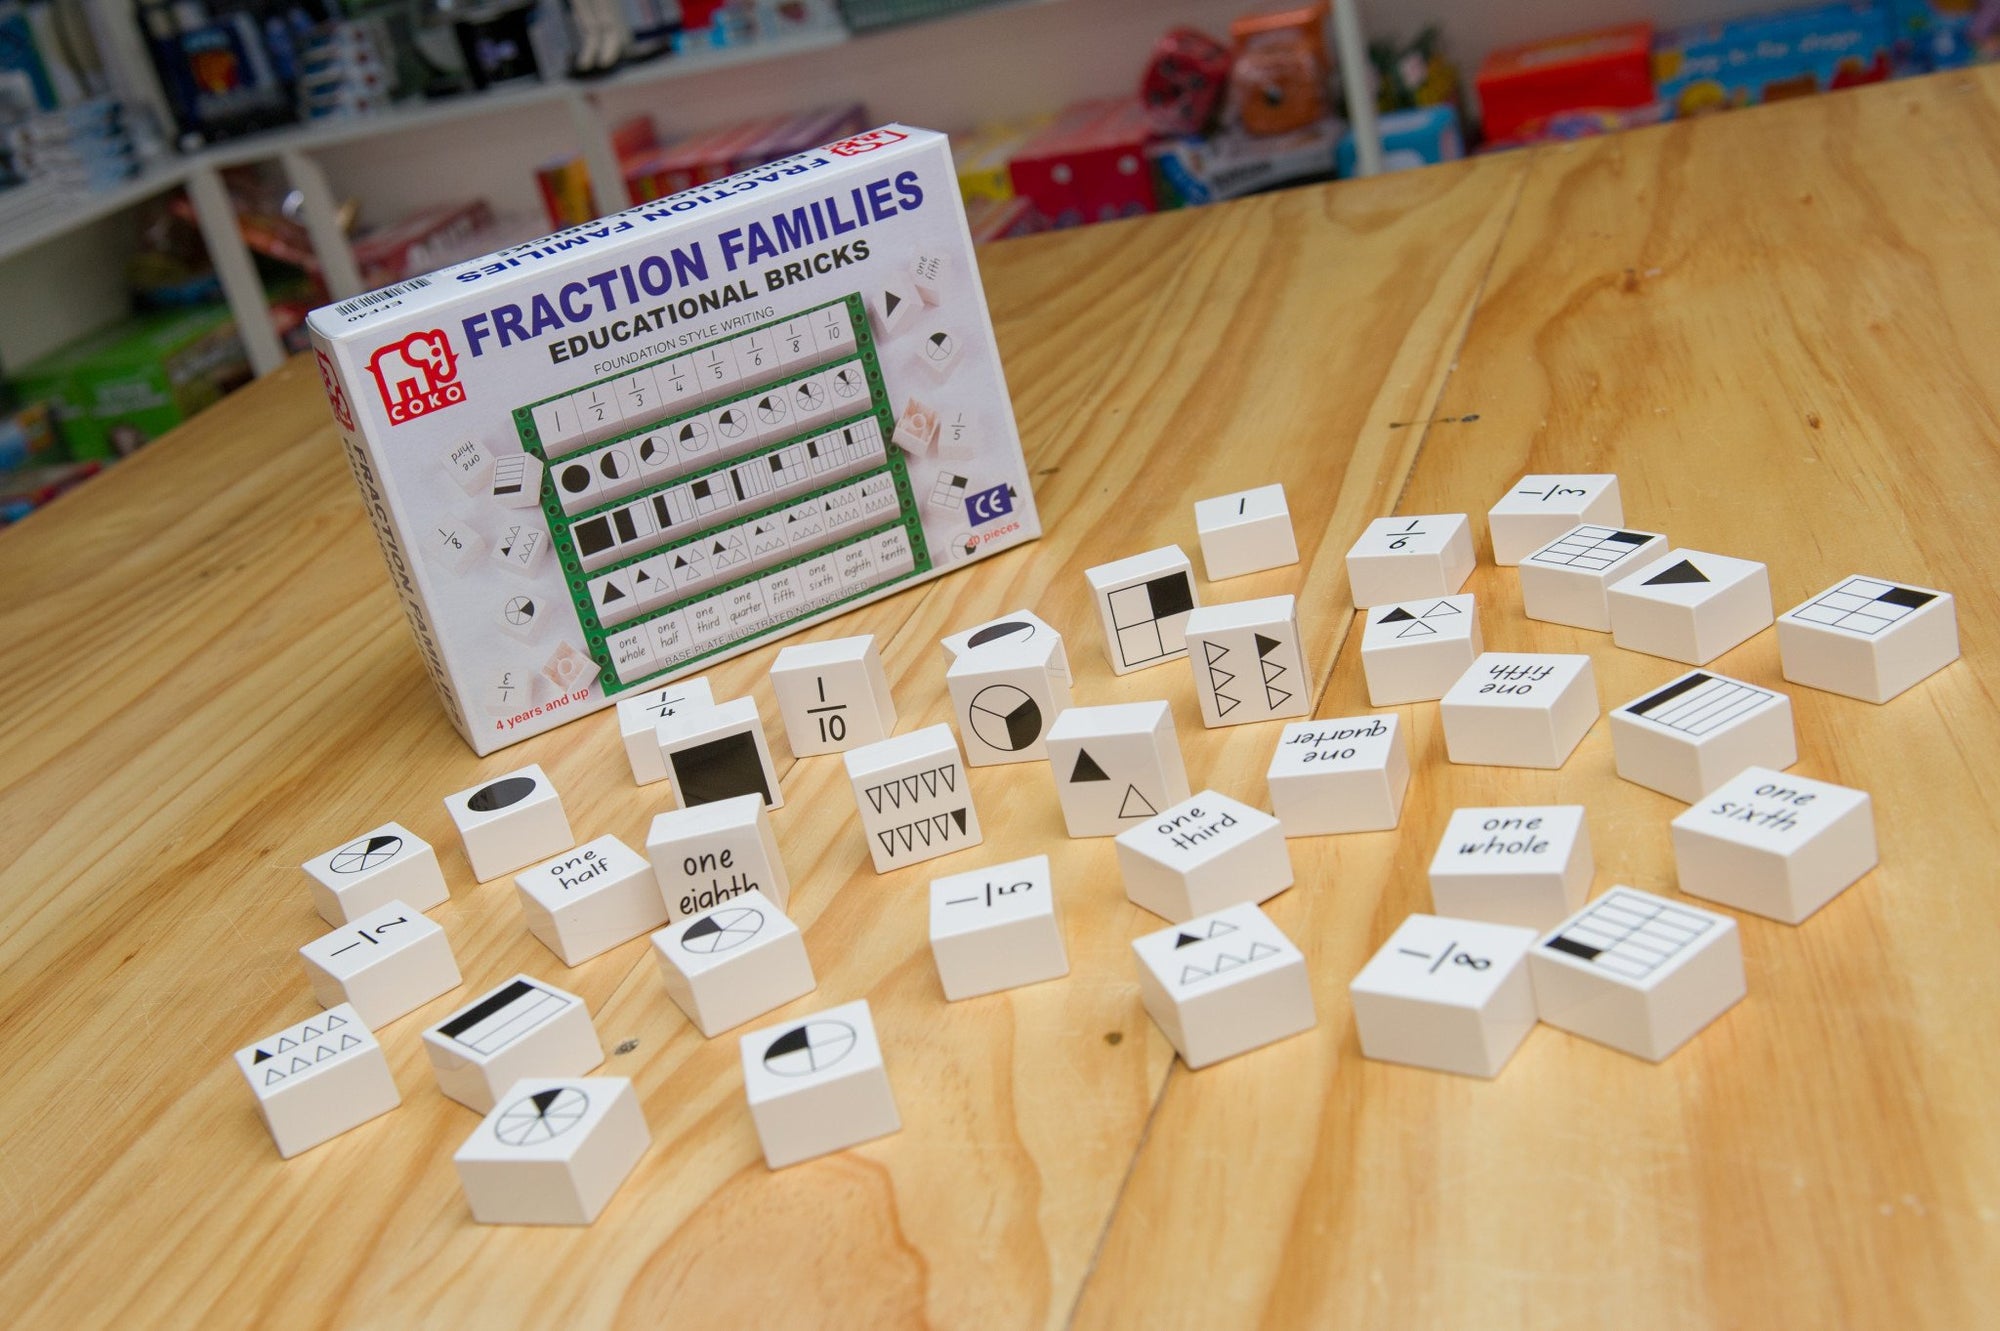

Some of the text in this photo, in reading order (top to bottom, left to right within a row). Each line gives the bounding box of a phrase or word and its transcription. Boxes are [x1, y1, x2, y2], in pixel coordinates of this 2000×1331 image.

[642, 157, 831, 222] FRACTION
[456, 220, 634, 283] FAMILIES
[461, 170, 924, 357] FRACTION FAMILIES
[916, 255, 928, 276] one
[548, 239, 870, 364] EDUCATIONAL BRICKS
[594, 306, 775, 375] FOUNDATION STYLE WRITING
[391, 386, 461, 421] COKO
[451, 440, 476, 465] third
[463, 454, 480, 472] one
[353, 443, 414, 596] FRACTION
[881, 535, 899, 548] one
[983, 521, 1020, 543] pieces
[845, 549, 864, 562] one
[880, 546, 907, 562] tenth
[809, 564, 827, 577] one
[844, 559, 872, 578] eighth
[771, 577, 789, 590] one
[809, 574, 834, 591] sixth
[733, 592, 751, 605] one
[773, 588, 795, 605] fifth
[695, 606, 714, 619] one
[730, 602, 763, 627] quarter
[657, 621, 676, 634] one
[664, 581, 869, 666] BASE PLATE ILLUSTRATED NOT INCLUDED
[697, 617, 721, 633] third
[619, 635, 637, 649] one
[660, 631, 680, 648] half
[619, 646, 647, 664] whole
[1488, 663, 1555, 683] fifth
[1479, 682, 1533, 697] one
[495, 687, 590, 731] 4 years and up
[1285, 718, 1388, 748] quarter
[1302, 747, 1357, 764] one
[1754, 783, 1818, 807] one
[1158, 805, 1207, 837] one
[1482, 815, 1544, 832] one
[1711, 800, 1799, 833] sixth
[1170, 812, 1239, 853] third
[1458, 834, 1551, 856] whole
[550, 849, 598, 877] one
[558, 856, 610, 890] half
[683, 848, 735, 877] one
